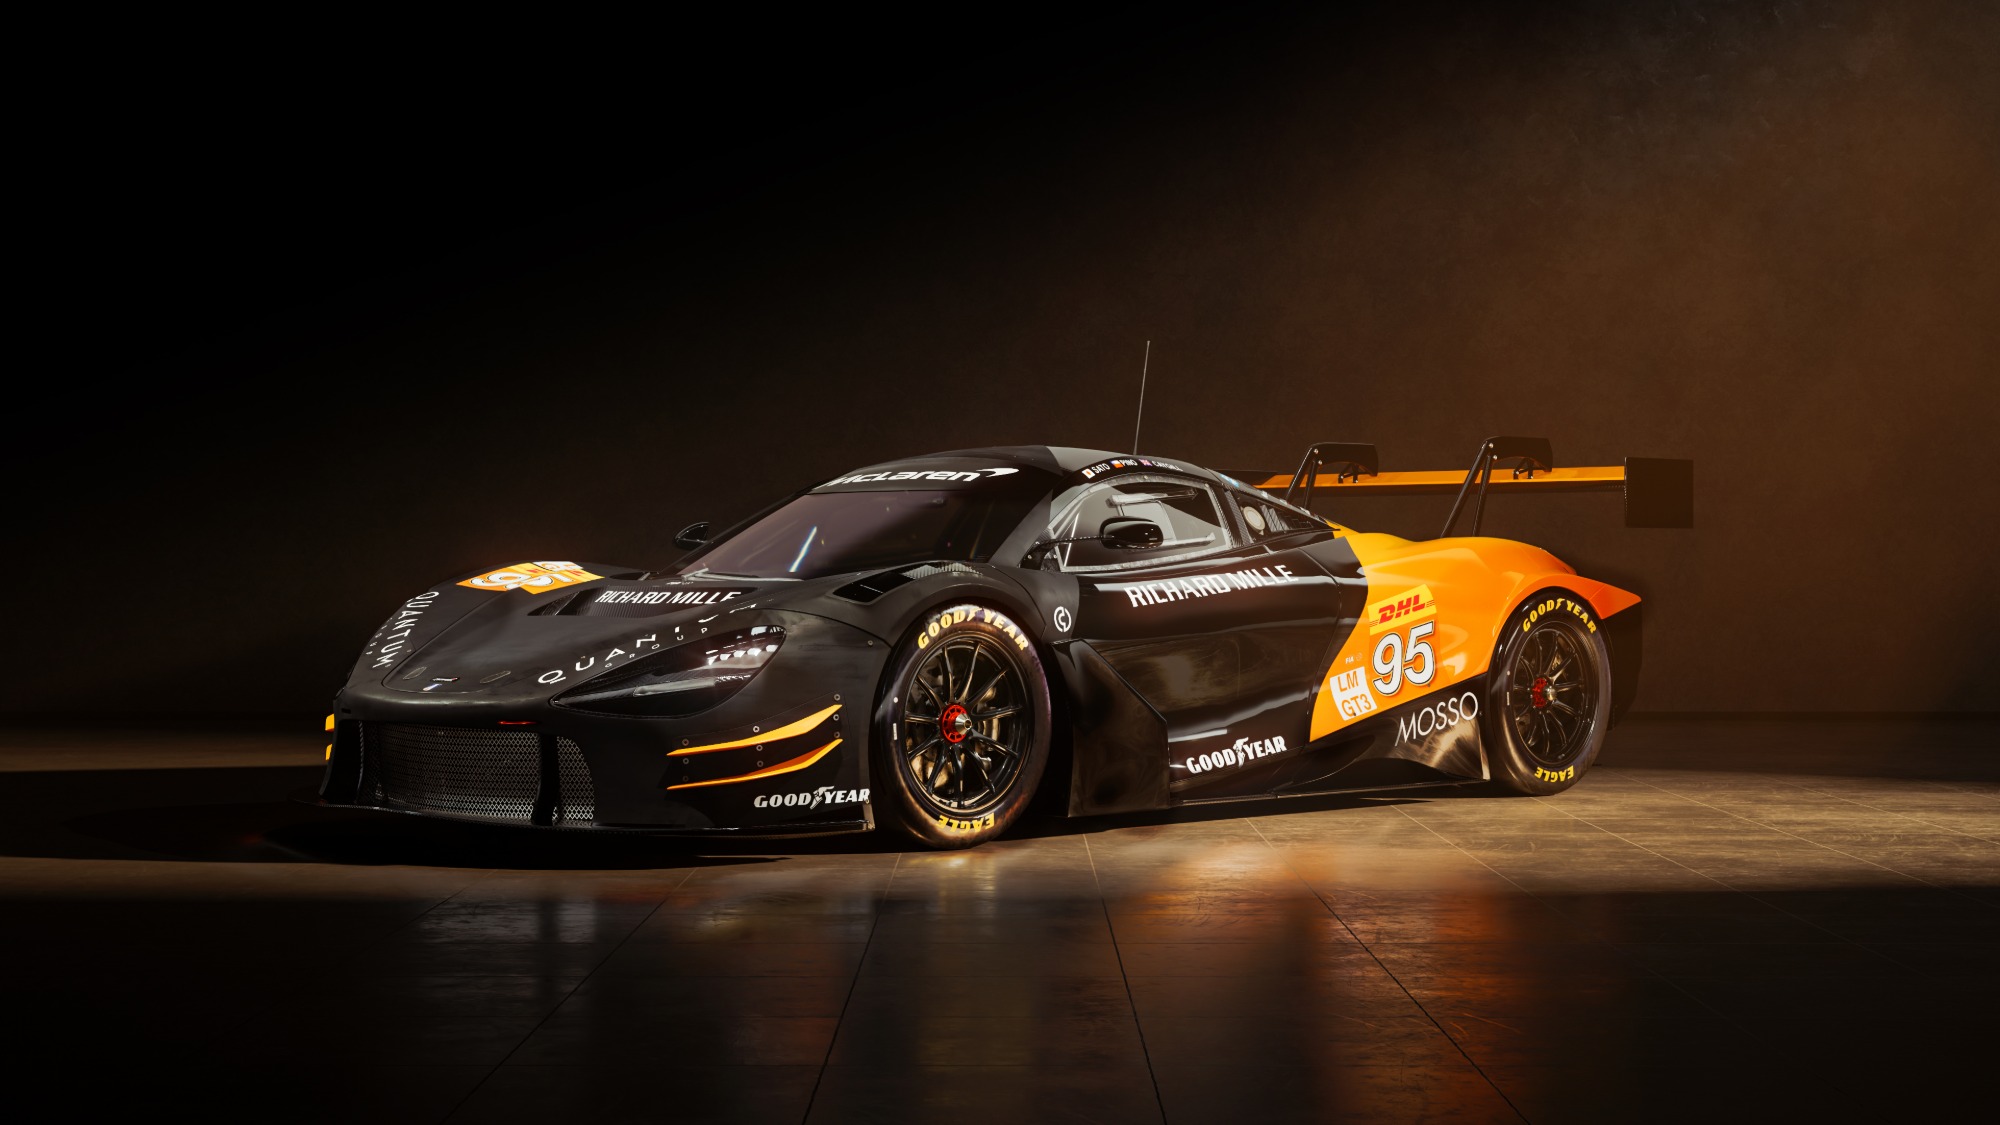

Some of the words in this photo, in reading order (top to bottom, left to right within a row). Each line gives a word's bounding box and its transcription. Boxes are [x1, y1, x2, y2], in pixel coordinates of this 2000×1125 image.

[1091, 463, 1111, 474] SATO
[595, 590, 671, 605] RICHARD
[1123, 573, 1231, 608] RICHARD
[1227, 564, 1299, 591] MILLE
[1378, 594, 1426, 624] DHL
[372, 591, 440, 668] QUANTUM
[1372, 621, 1436, 697] 95
[1337, 670, 1359, 692] LM
[1341, 693, 1372, 717] GT3
[1394, 692, 1479, 747] MOSSO
[1534, 765, 1574, 783] EAGLE
[938, 812, 996, 835] EAGLE
